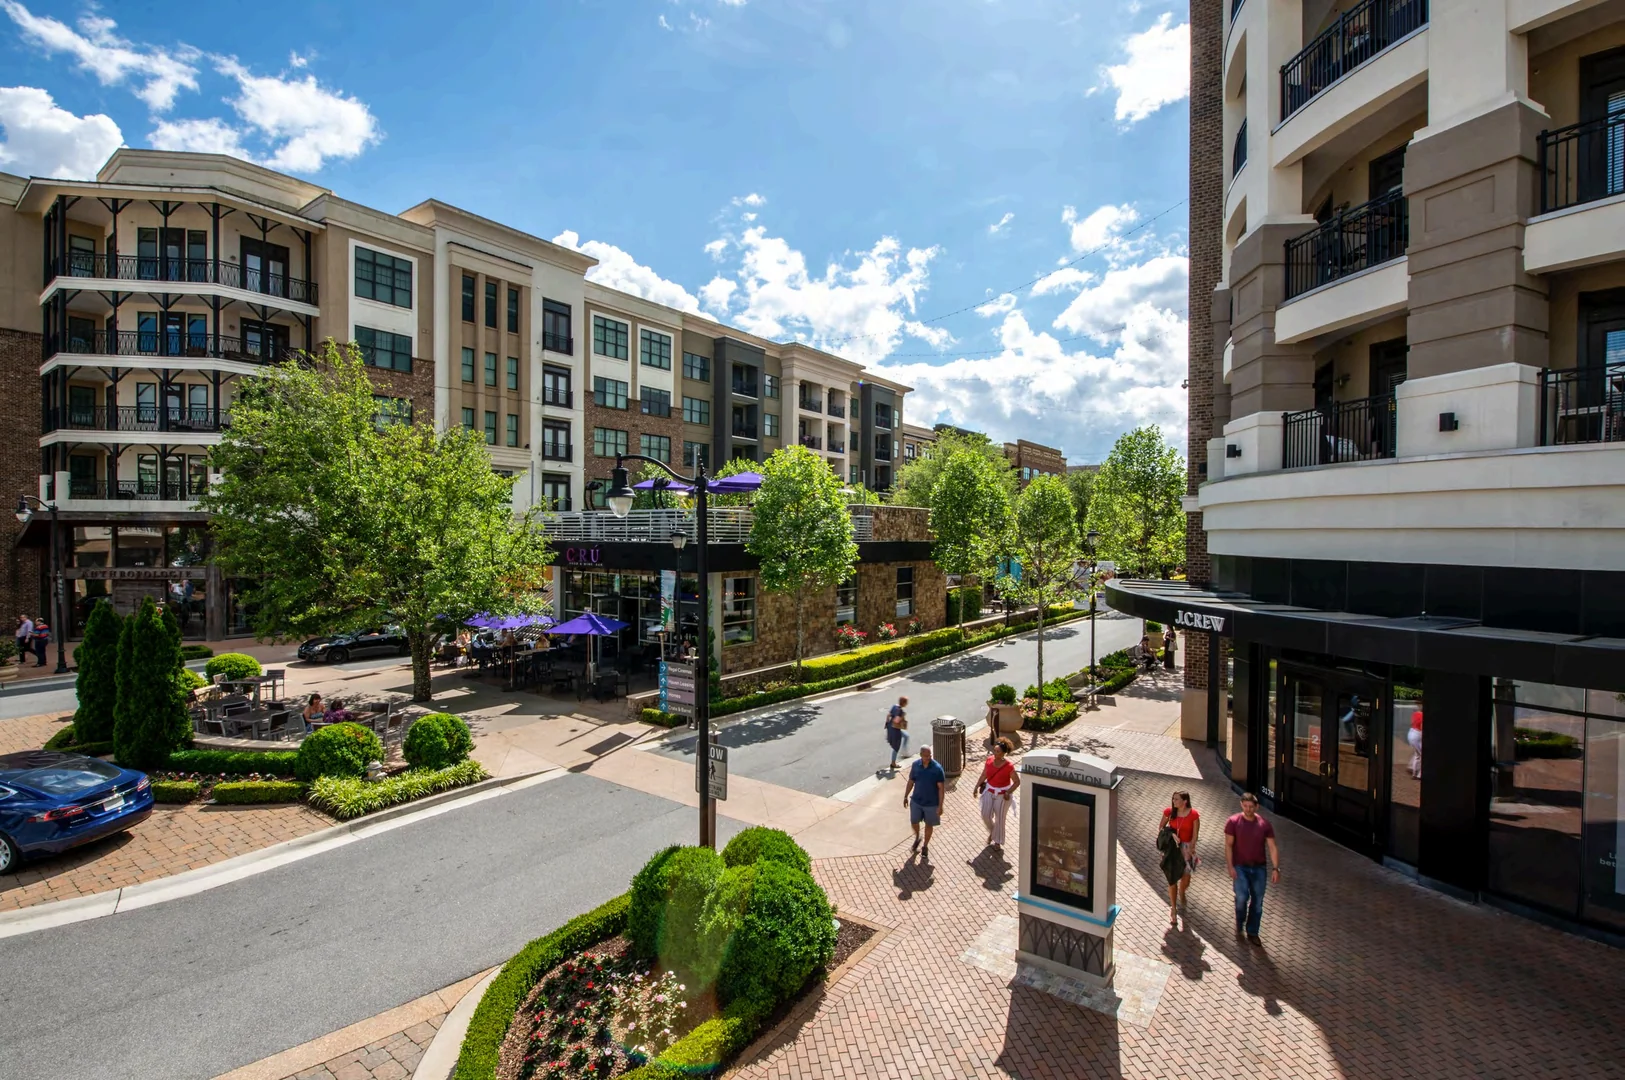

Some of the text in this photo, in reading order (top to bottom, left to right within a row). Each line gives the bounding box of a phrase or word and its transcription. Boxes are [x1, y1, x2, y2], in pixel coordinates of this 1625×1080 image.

[566, 544, 599, 563] CRÚ
[82, 570, 193, 579] ANTHROPOLOGIE
[1175, 610, 1225, 632] J.CREW
[710, 747, 724, 760] OW
[1023, 764, 1102, 785] INFORMATION
